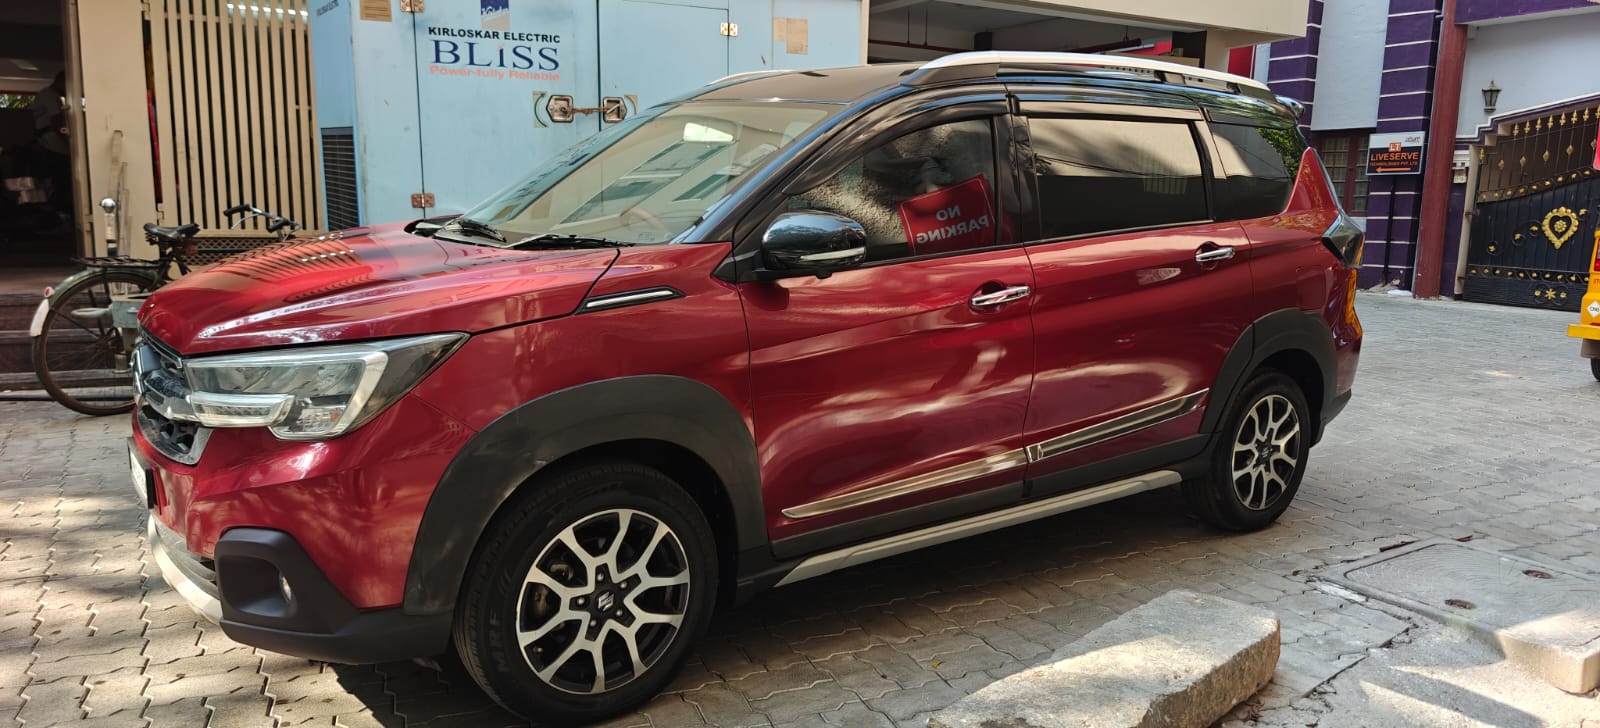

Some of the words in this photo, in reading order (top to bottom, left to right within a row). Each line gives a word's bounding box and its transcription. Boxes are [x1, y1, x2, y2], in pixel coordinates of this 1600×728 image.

[428, 27, 500, 40] KIRLOSKAR
[504, 32, 561, 44] ELECTRIC
[429, 65, 505, 80] Power-fully
[509, 69, 560, 81] Reliable
[1390, 143, 1401, 151] LT
[1371, 152, 1419, 161] LIVESERVE
